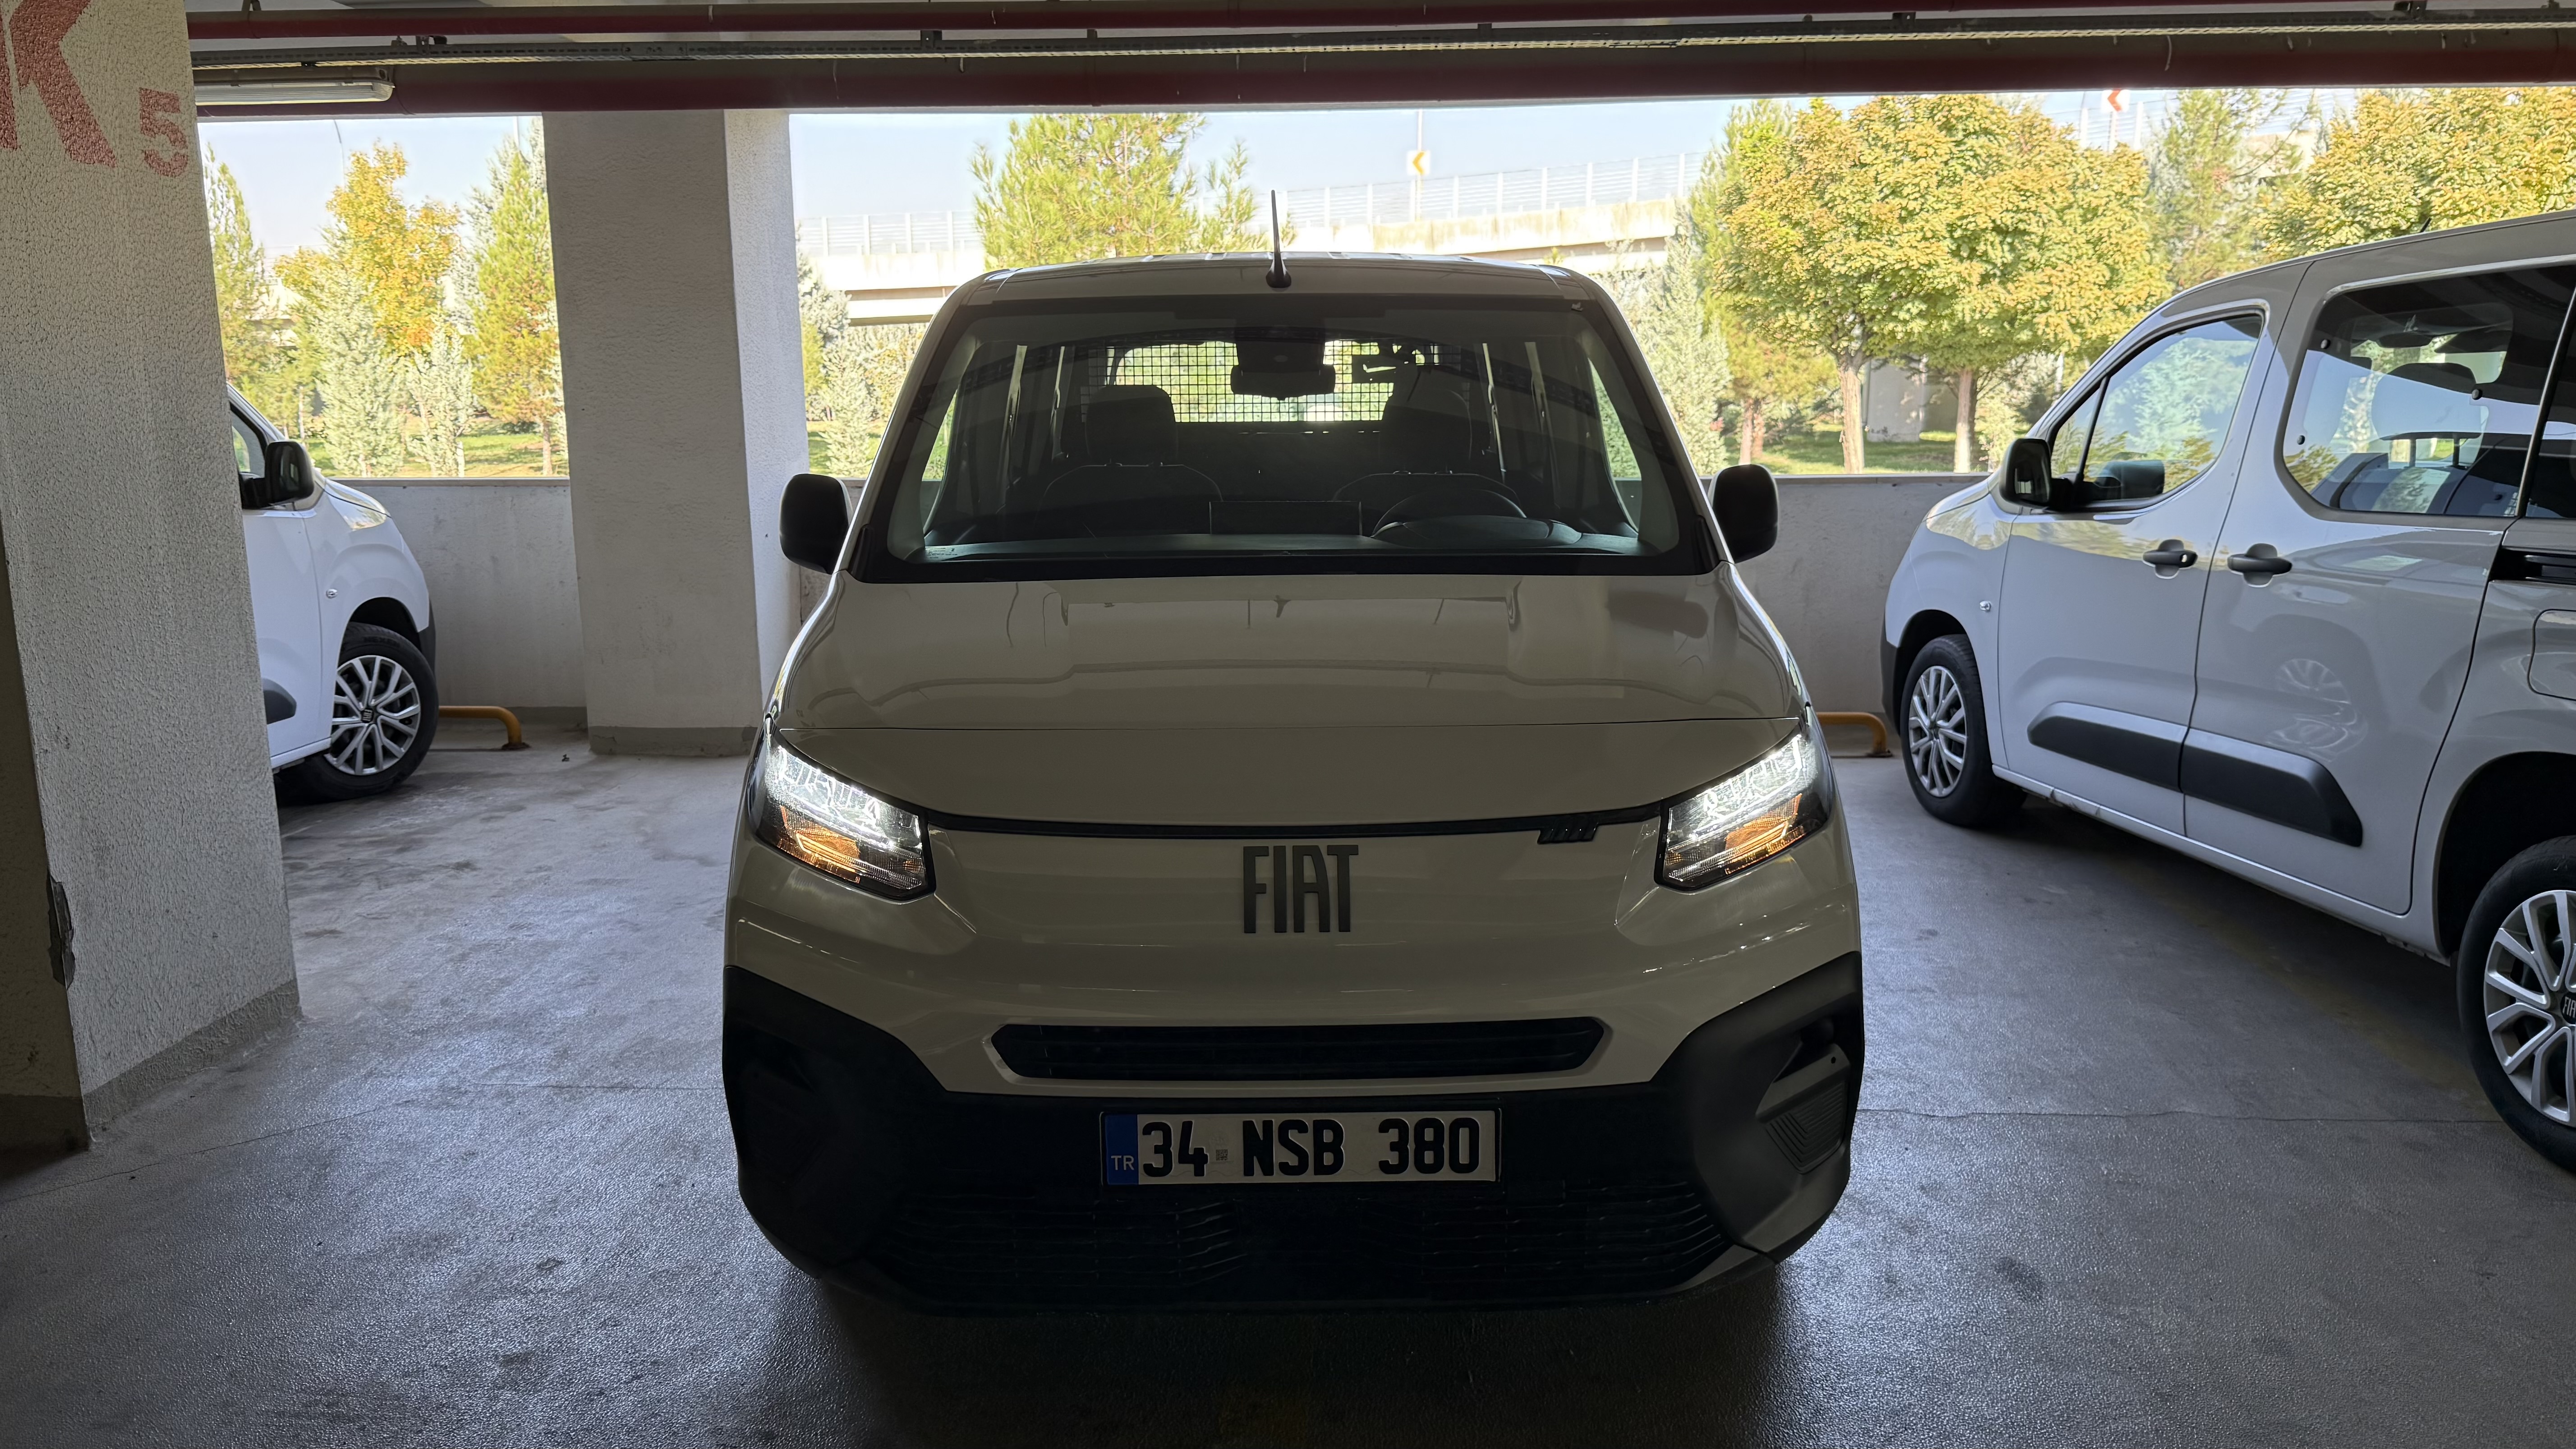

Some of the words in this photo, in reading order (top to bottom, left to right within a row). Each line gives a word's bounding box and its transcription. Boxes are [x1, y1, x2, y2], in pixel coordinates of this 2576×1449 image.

[139, 87, 188, 177] 5
[1243, 845, 1359, 933] FIAT
[2562, 996, 2576, 1018] FIA
[1111, 1155, 1134, 1171] TR
[1142, 1121, 1208, 1177] 34
[1243, 1119, 1344, 1176] NSB
[1379, 1118, 1479, 1173] 380
